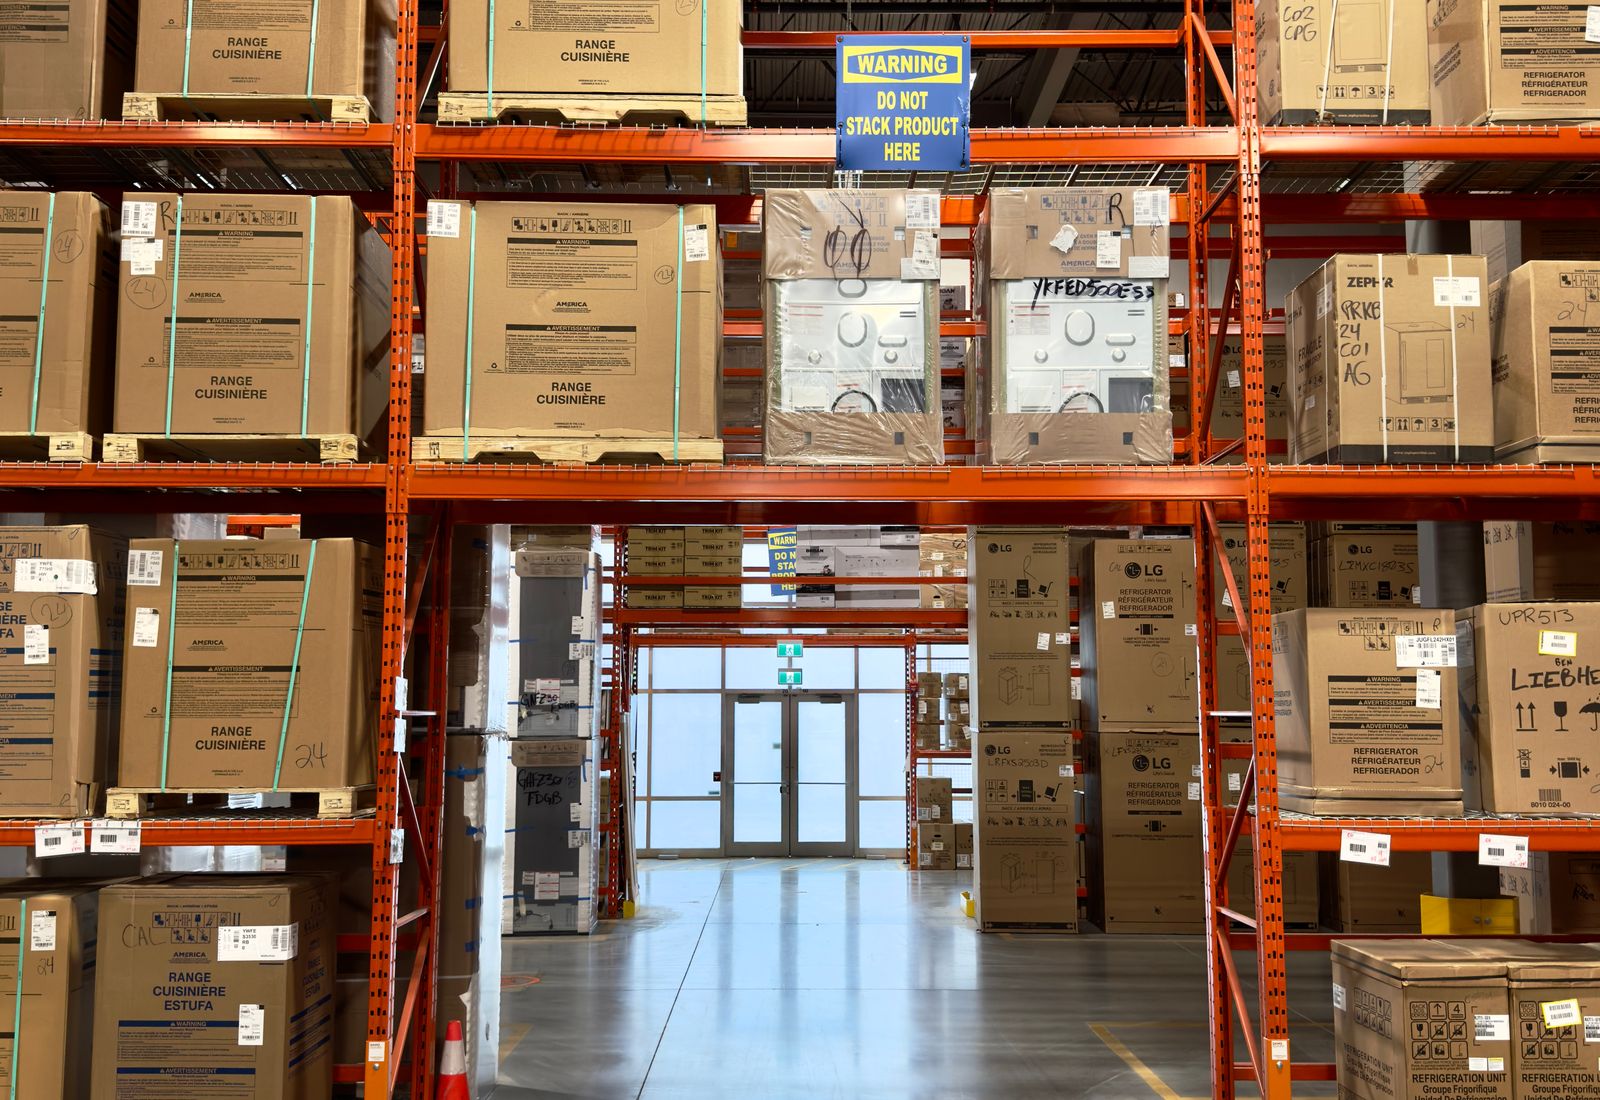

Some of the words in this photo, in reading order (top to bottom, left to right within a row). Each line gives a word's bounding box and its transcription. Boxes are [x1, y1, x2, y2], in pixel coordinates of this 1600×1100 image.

[1284, 23, 1317, 42] CPG
[228, 37, 268, 47] RANGE
[575, 39, 616, 50] RANGE
[212, 48, 282, 60] CUISINIÈRE
[560, 50, 630, 62] CUISINIÈRE
[857, 54, 948, 74] WARNING
[1523, 71, 1585, 79] REFRIGERATOR
[1521, 79, 1588, 88] RÉFRIGÉRATEUR
[877, 91, 897, 110] DO
[900, 91, 928, 110] NOT
[846, 116, 891, 136] STACK
[895, 117, 958, 136] PRODUCT
[884, 142, 920, 161] HERE
[1109, 193, 1126, 226] R
[160, 201, 175, 231] R
[1346, 276, 1394, 288] ZEPHR
[1340, 300, 1381, 321] PRKB
[1557, 300, 1588, 327] 24
[1456, 311, 1475, 334] 24
[1339, 323, 1361, 341] 24
[1343, 360, 1371, 387] AG
[210, 376, 253, 386] RANGE
[551, 382, 592, 392] RANGE
[194, 387, 268, 400] CUISINIÈRE
[536, 393, 606, 405] CUISINIÈRE
[1000, 544, 1012, 552] LG
[1360, 546, 1372, 554] LG
[774, 551, 787, 560] DO
[1144, 564, 1163, 576] LG
[1118, 596, 1173, 604] RÉFRIGÉRATEUR
[211, 726, 252, 737] RANGE
[195, 737, 266, 751] CUISINIÈRE
[295, 741, 328, 769] 24
[998, 746, 1011, 755] LG
[1353, 747, 1418, 755] REFRIGERATOR
[1153, 757, 1171, 769] LG
[1351, 756, 1421, 765] RÉFRIGÉRATEUR
[1353, 767, 1420, 775] REFRIGERADOR
[1126, 790, 1182, 798] RÉFRIGÉRATEUR
[37, 956, 54, 976] 24
[168, 972, 211, 983] RANGE
[152, 983, 226, 997] CUISINIÈRE
[164, 1000, 214, 1011] ESTUFA
[1453, 1004, 1461, 1013] 4
[1412, 1074, 1485, 1083] REFRIGERATION
[1486, 1074, 1507, 1083] UNIT
[1521, 1073, 1594, 1083] REFRIGERATION
[1422, 1085, 1451, 1095] Groupe
[1453, 1084, 1497, 1096] Frigorifique
[1532, 1084, 1561, 1095] Groupe
